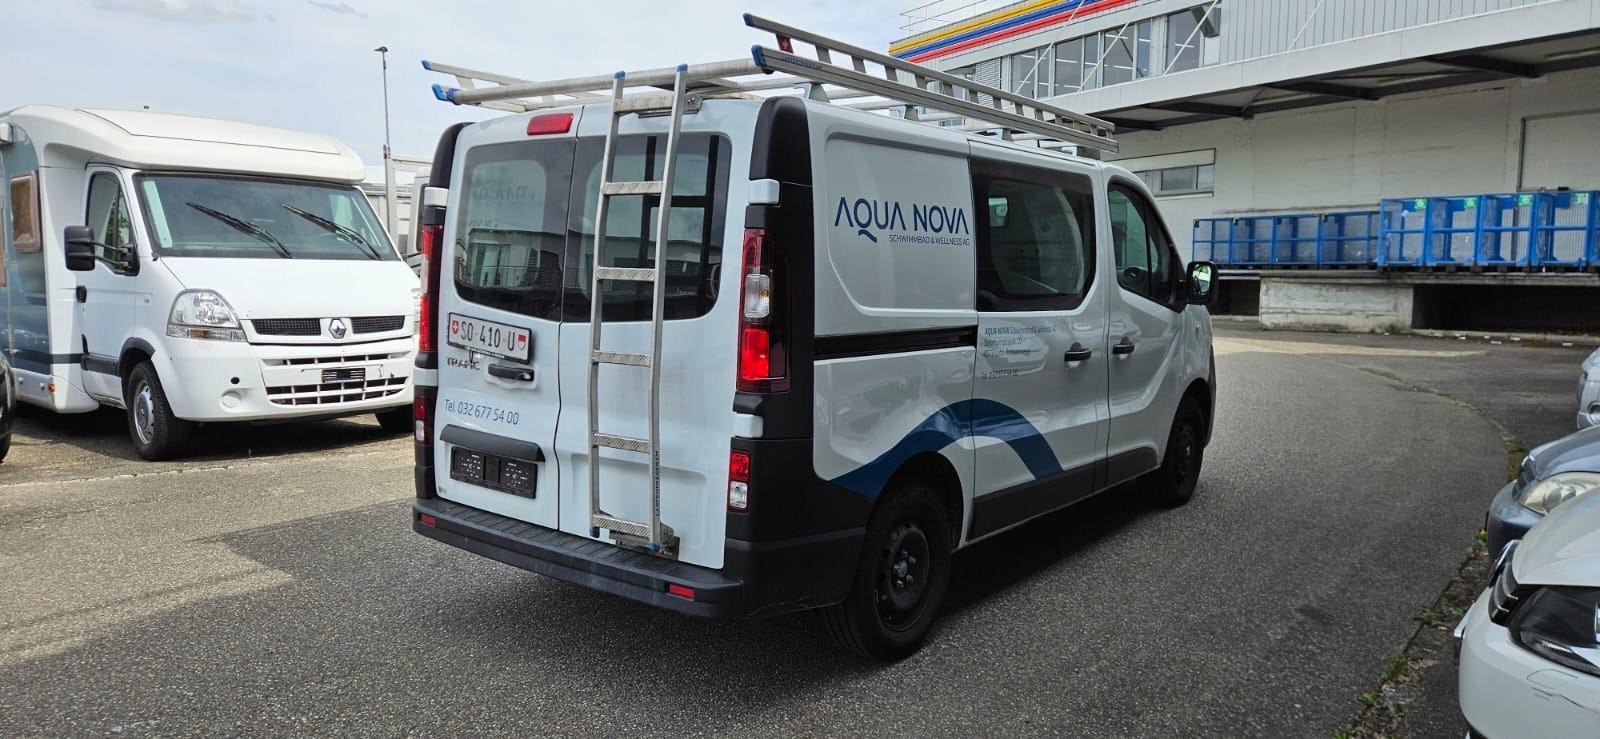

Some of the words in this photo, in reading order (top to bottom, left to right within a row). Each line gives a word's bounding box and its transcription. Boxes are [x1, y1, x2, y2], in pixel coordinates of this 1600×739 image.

[834, 196, 906, 243] AQUA
[913, 203, 969, 234] NOVA
[889, 234, 930, 244] SCHWIMMBAD
[934, 237, 963, 246] WELLNESS
[963, 238, 970, 246] AG
[458, 401, 474, 416] 032
[474, 405, 492, 419] 677
[493, 408, 504, 421] 54
[507, 411, 520, 425] 00
